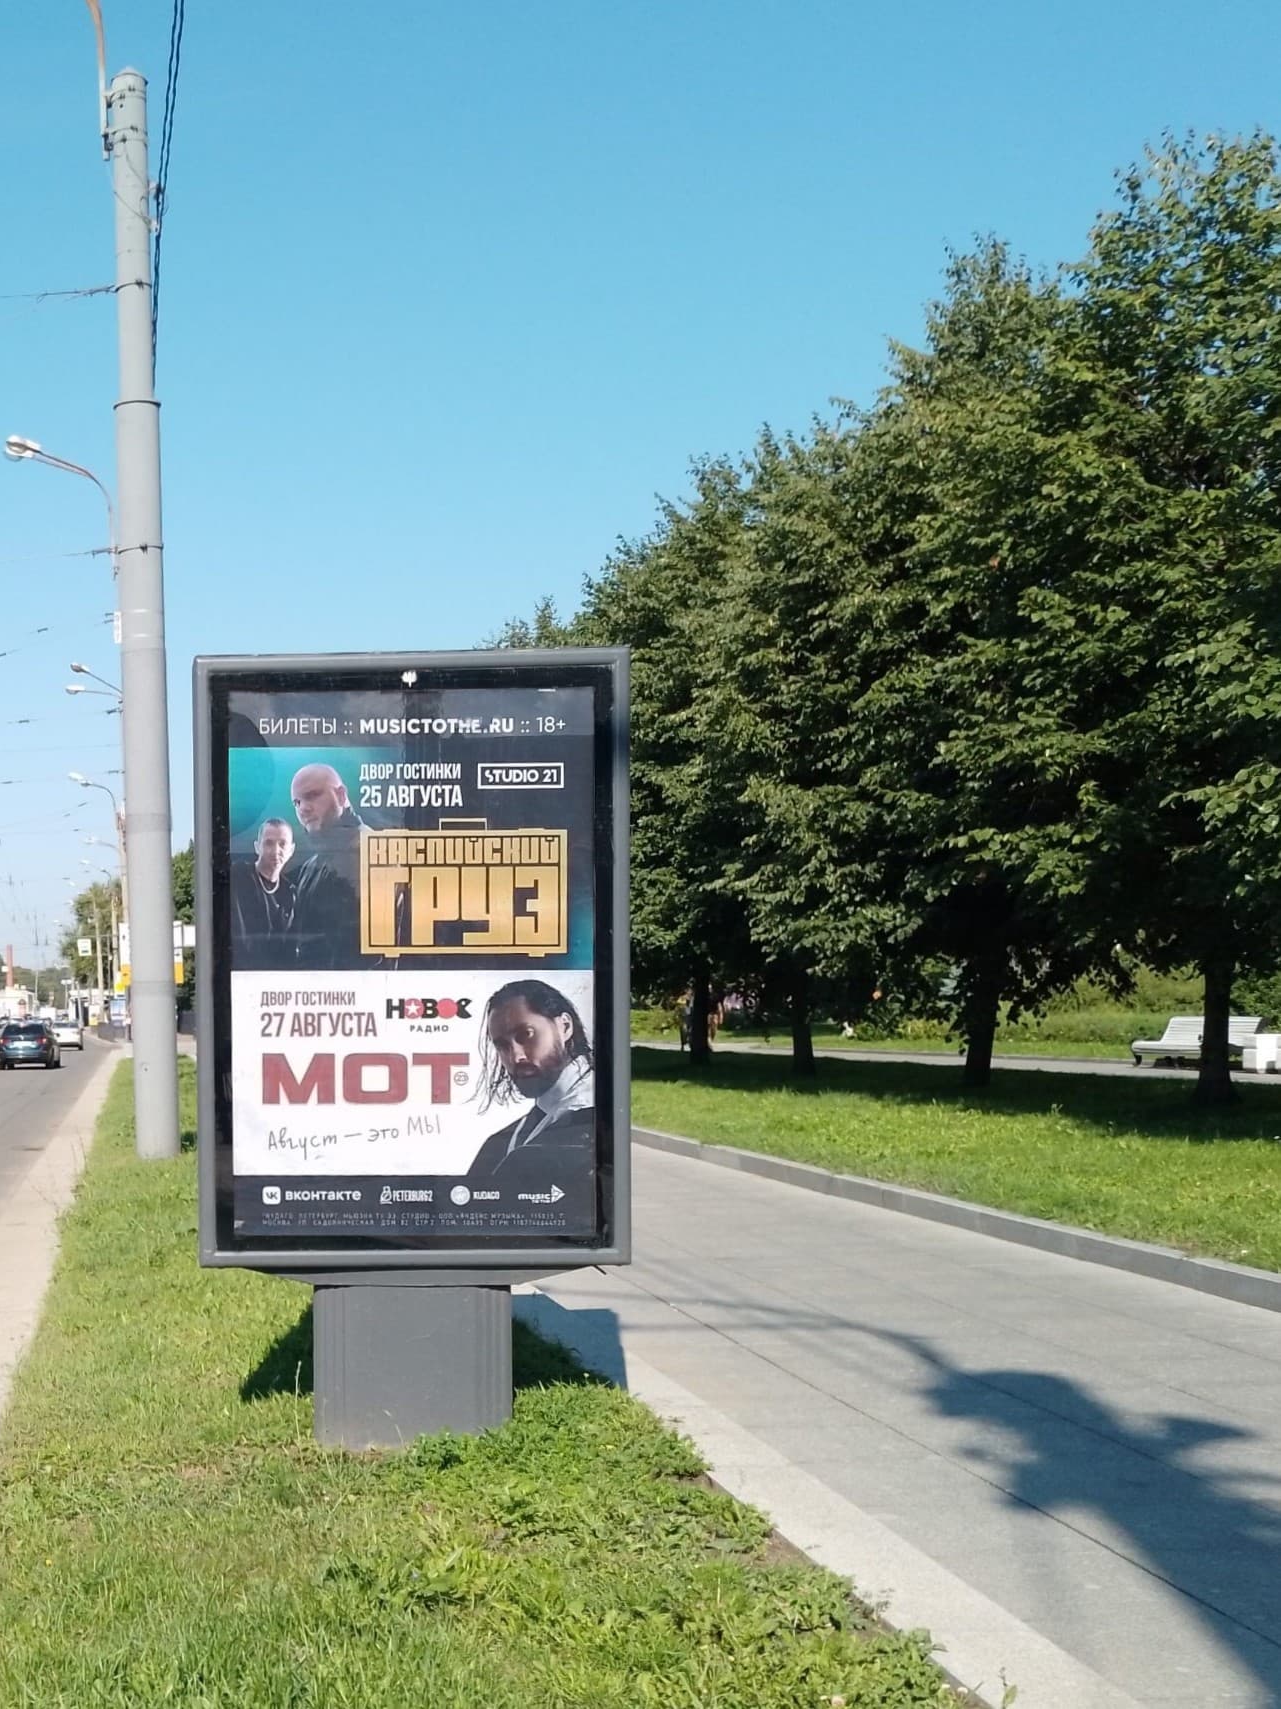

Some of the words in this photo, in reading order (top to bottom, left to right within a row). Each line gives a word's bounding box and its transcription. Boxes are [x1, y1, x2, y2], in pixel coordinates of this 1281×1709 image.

[259, 717, 337, 735] БИЛЕТЫ
[359, 718, 514, 734] MUSICTOTHE.RU
[535, 716, 566, 733] 18+
[359, 763, 394, 780] ДВОР
[396, 762, 462, 780] ГОСТИНКИ
[484, 769, 538, 784] STUDIO
[542, 769, 558, 783] 21
[360, 786, 381, 808] 25
[386, 785, 463, 808] АВГУСТА
[370, 836, 559, 865] КАСПИЙСКИЙ
[370, 866, 559, 946] ГРУЗ
[260, 991, 292, 1007] ДВОР
[295, 990, 356, 1006] ГОСТИНКИ
[260, 1012, 285, 1038] 27
[290, 1012, 377, 1038] АВГУСТА
[409, 1024, 449, 1033] РАДИО
[261, 1052, 470, 1105] МОТ
[268, 1129, 338, 1159] Август
[367, 1126, 400, 1144] это
[407, 1114, 441, 1138] МЫ
